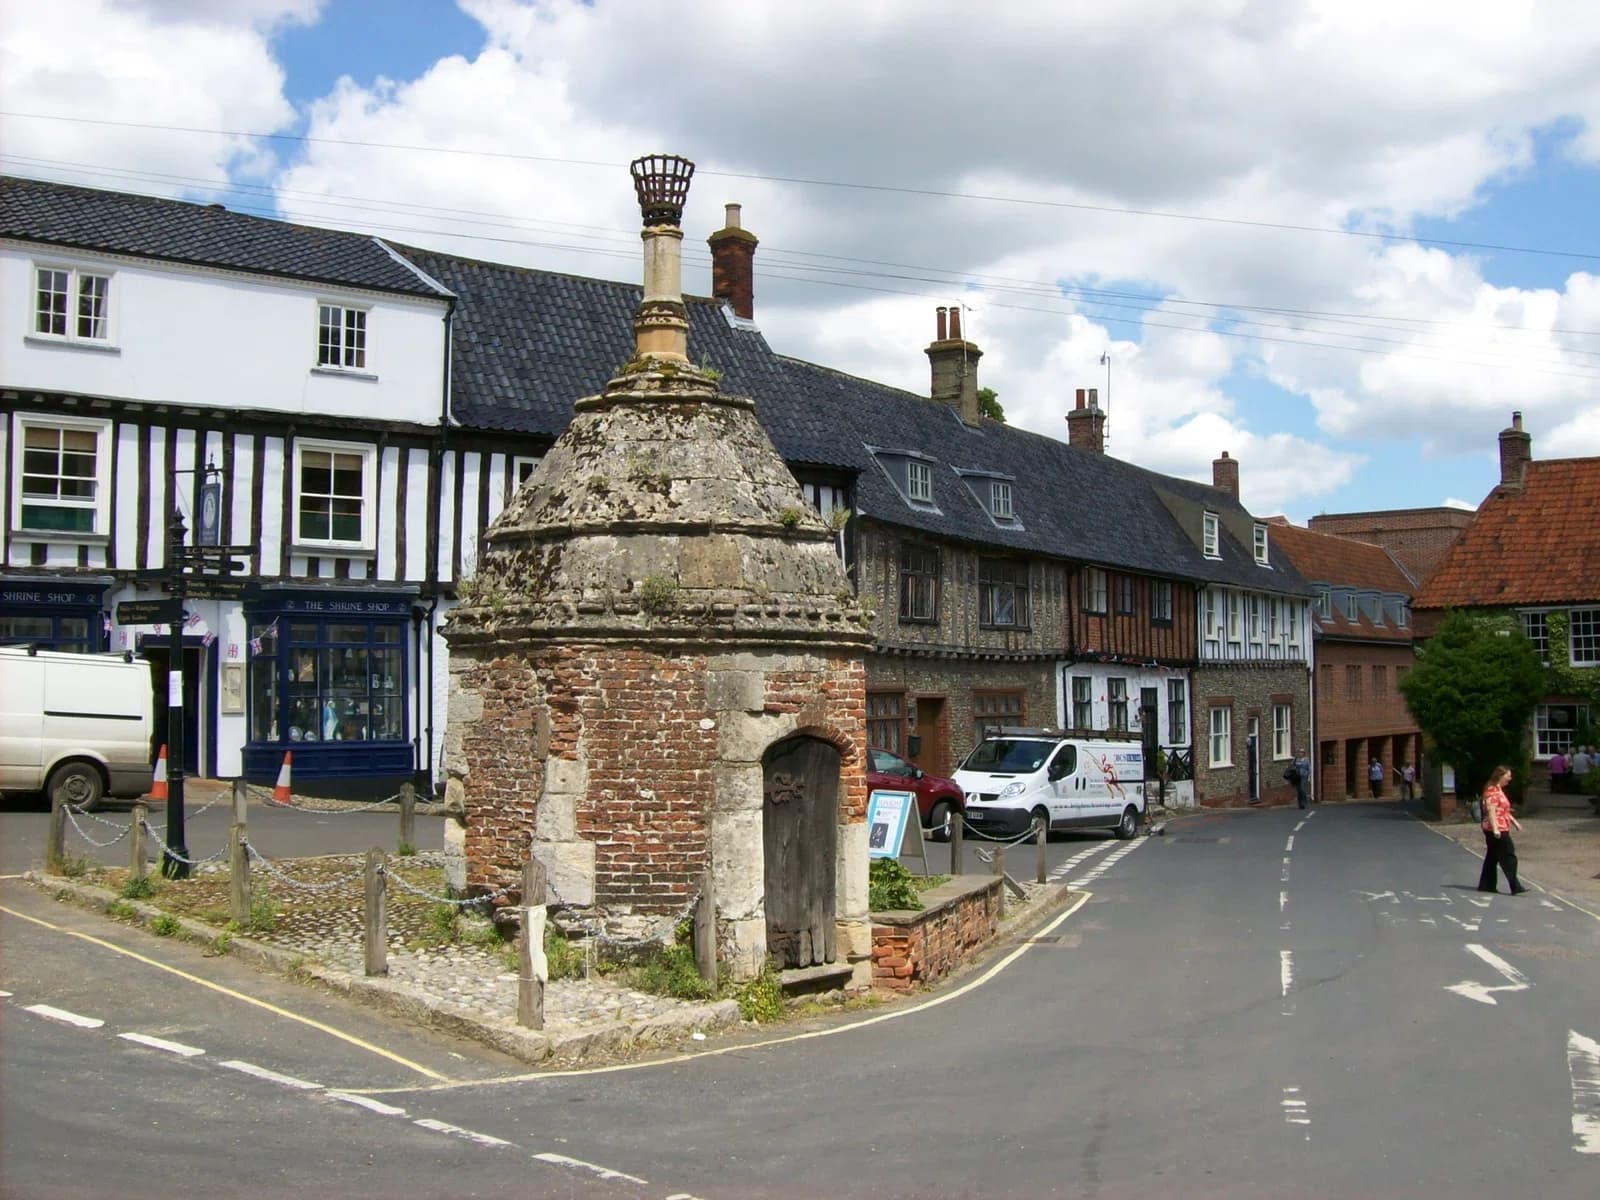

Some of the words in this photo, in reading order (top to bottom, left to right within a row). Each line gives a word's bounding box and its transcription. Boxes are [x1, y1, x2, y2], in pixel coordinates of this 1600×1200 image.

[3, 591, 41, 602] SHRINE
[47, 592, 76, 603] SHOP
[304, 600, 324, 610] THE
[329, 601, 363, 611] SHRINE
[367, 602, 390, 612] SHOP
